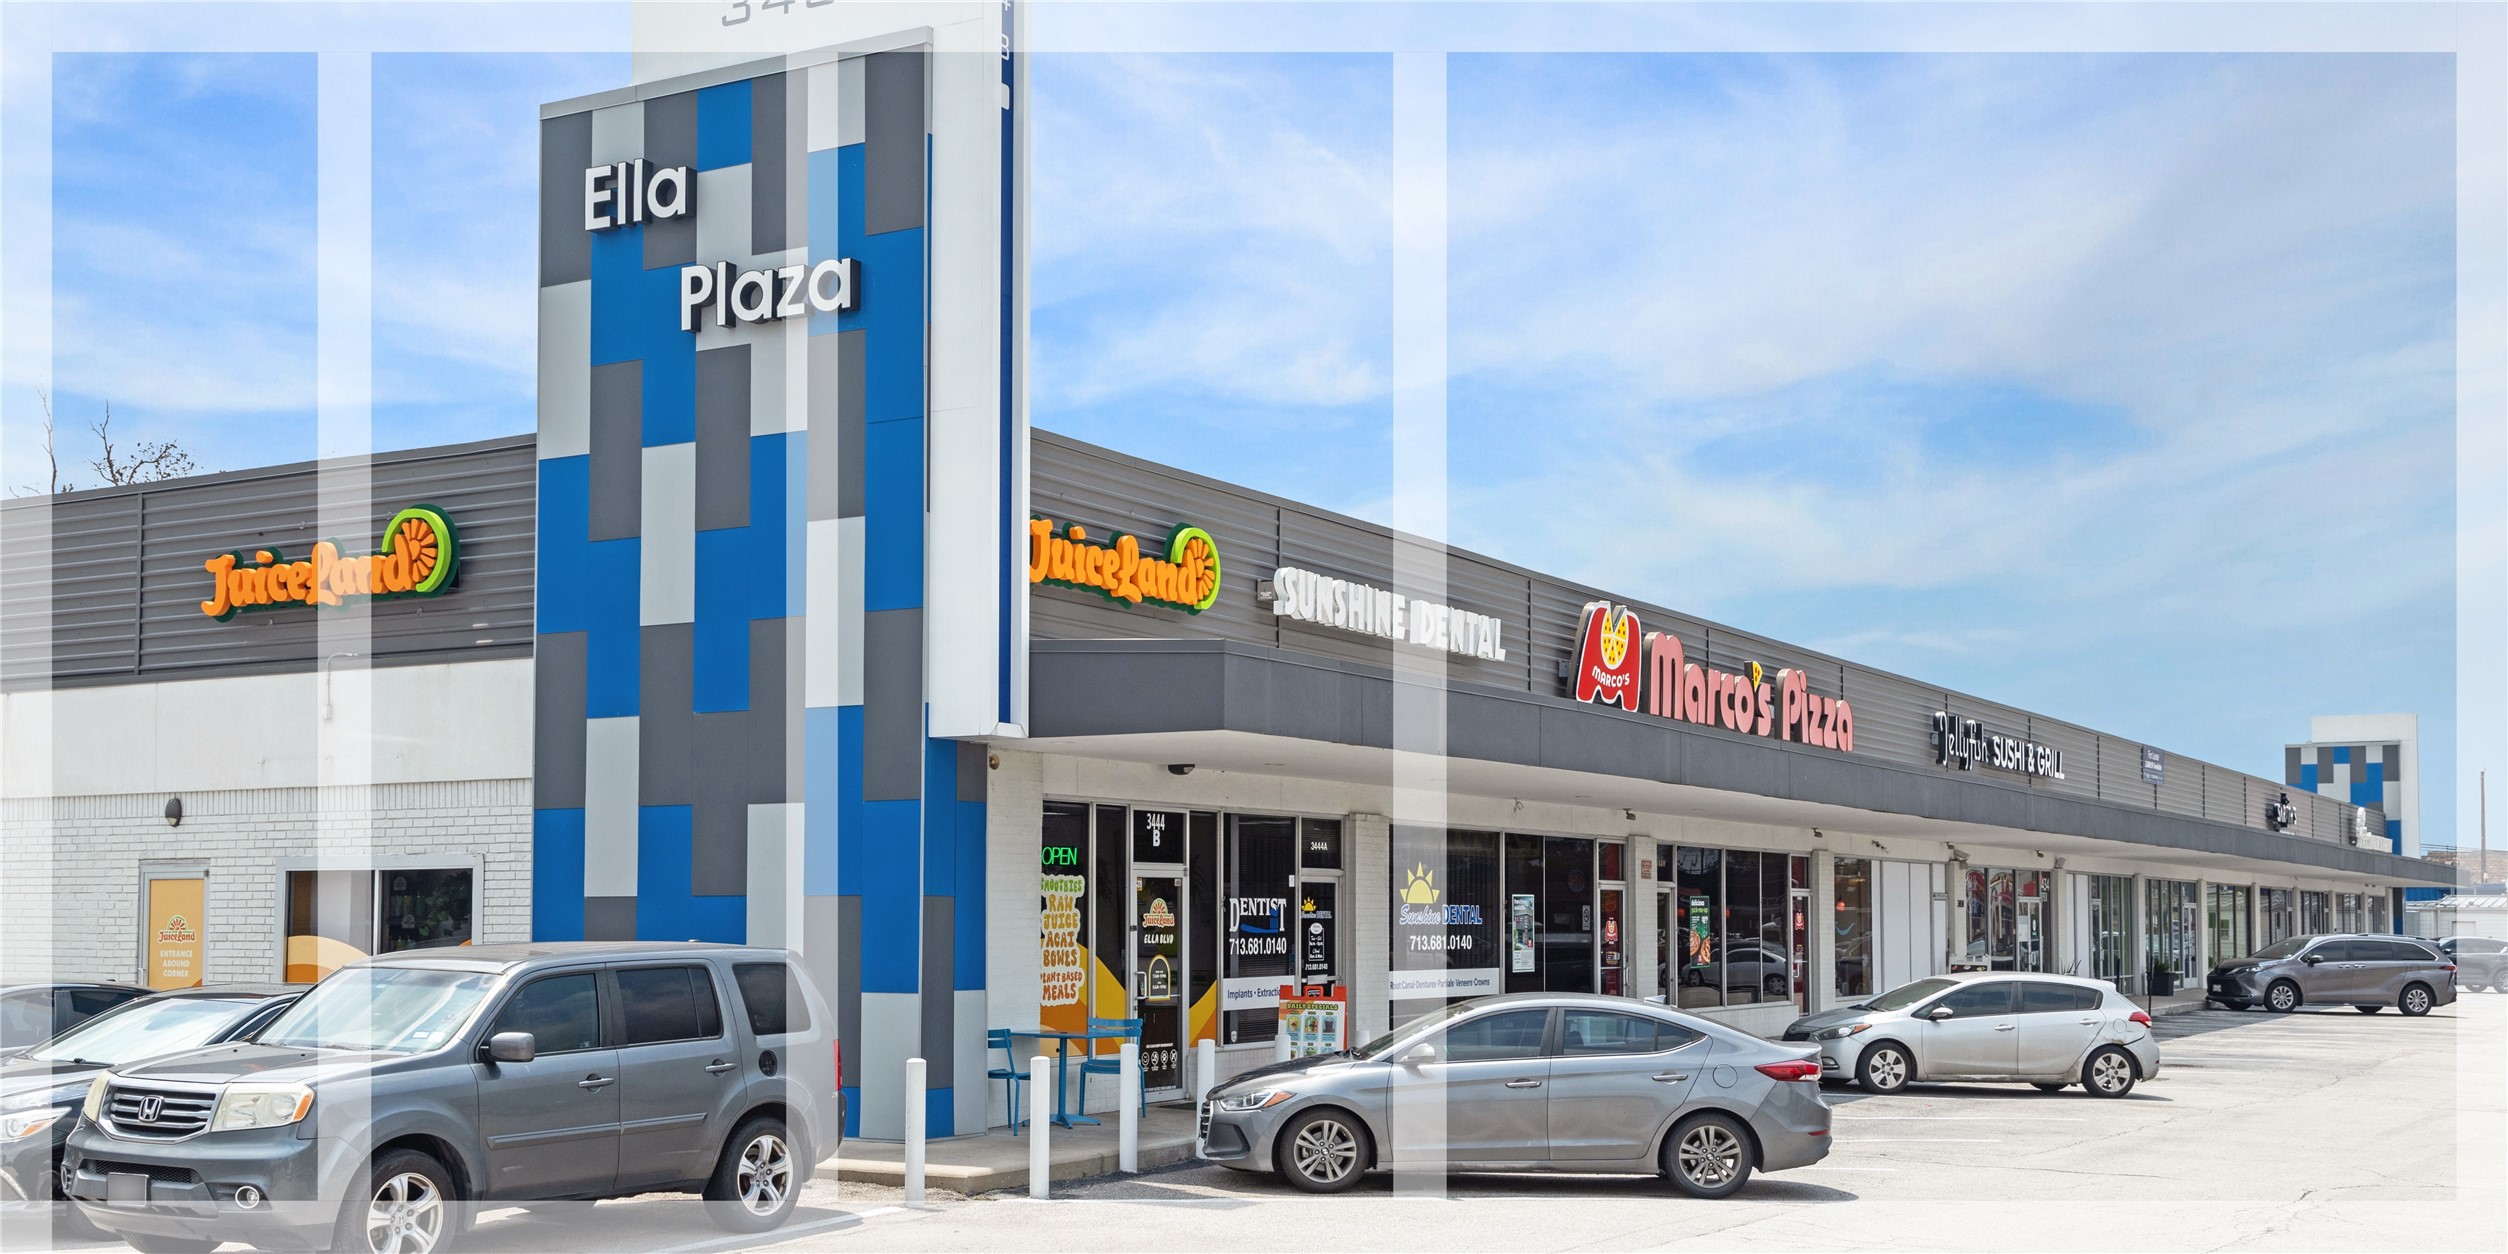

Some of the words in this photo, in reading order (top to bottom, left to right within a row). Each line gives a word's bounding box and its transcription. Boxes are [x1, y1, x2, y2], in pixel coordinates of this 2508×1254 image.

[585, 158, 692, 232] Ella
[681, 257, 856, 332] Plaza
[1030, 519, 1198, 606] JuiceLand
[201, 534, 414, 617] JuiceLand
[1274, 567, 1406, 640] SUNSHINE
[1410, 600, 1506, 662] DENTAL
[1592, 665, 1630, 688] MARCO'S
[1645, 631, 1771, 737] Marco's
[1776, 668, 1854, 752] Pizza
[1934, 711, 1988, 770] Jellyfish
[1993, 736, 2025, 772] SUSHI
[2027, 743, 2035, 773] &
[2037, 746, 2065, 780] GRILL
[1147, 813, 1165, 830] 3444
[1153, 829, 1160, 847] B
[1311, 842, 1328, 850] 3444A
[1042, 847, 1077, 865] OPEN
[1049, 894, 1073, 912] RAW
[1044, 912, 1078, 930] JUICE
[1229, 898, 1287, 932] DENTIST
[1399, 904, 1441, 925] Sunshine
[1442, 904, 1482, 925] DENTAL
[158, 930, 196, 943] JuiceLand
[1046, 931, 1075, 948] ACAI
[1144, 935, 1159, 944] ELLA
[1160, 934, 1174, 943] BLVD
[1409, 935, 1472, 950] 713.681.0140
[160, 950, 192, 958] ENTRANCE
[1229, 938, 1287, 955] 713.681.0140
[1043, 949, 1077, 967] BOWLS
[163, 969, 188, 977] CORNER
[1041, 972, 1060, 983] LANT
[1062, 971, 1082, 982] BASED
[1043, 983, 1076, 1000] MEALS
[1227, 989, 1253, 1000] Implants
[1307, 1003, 1339, 1011] SPECIALS
